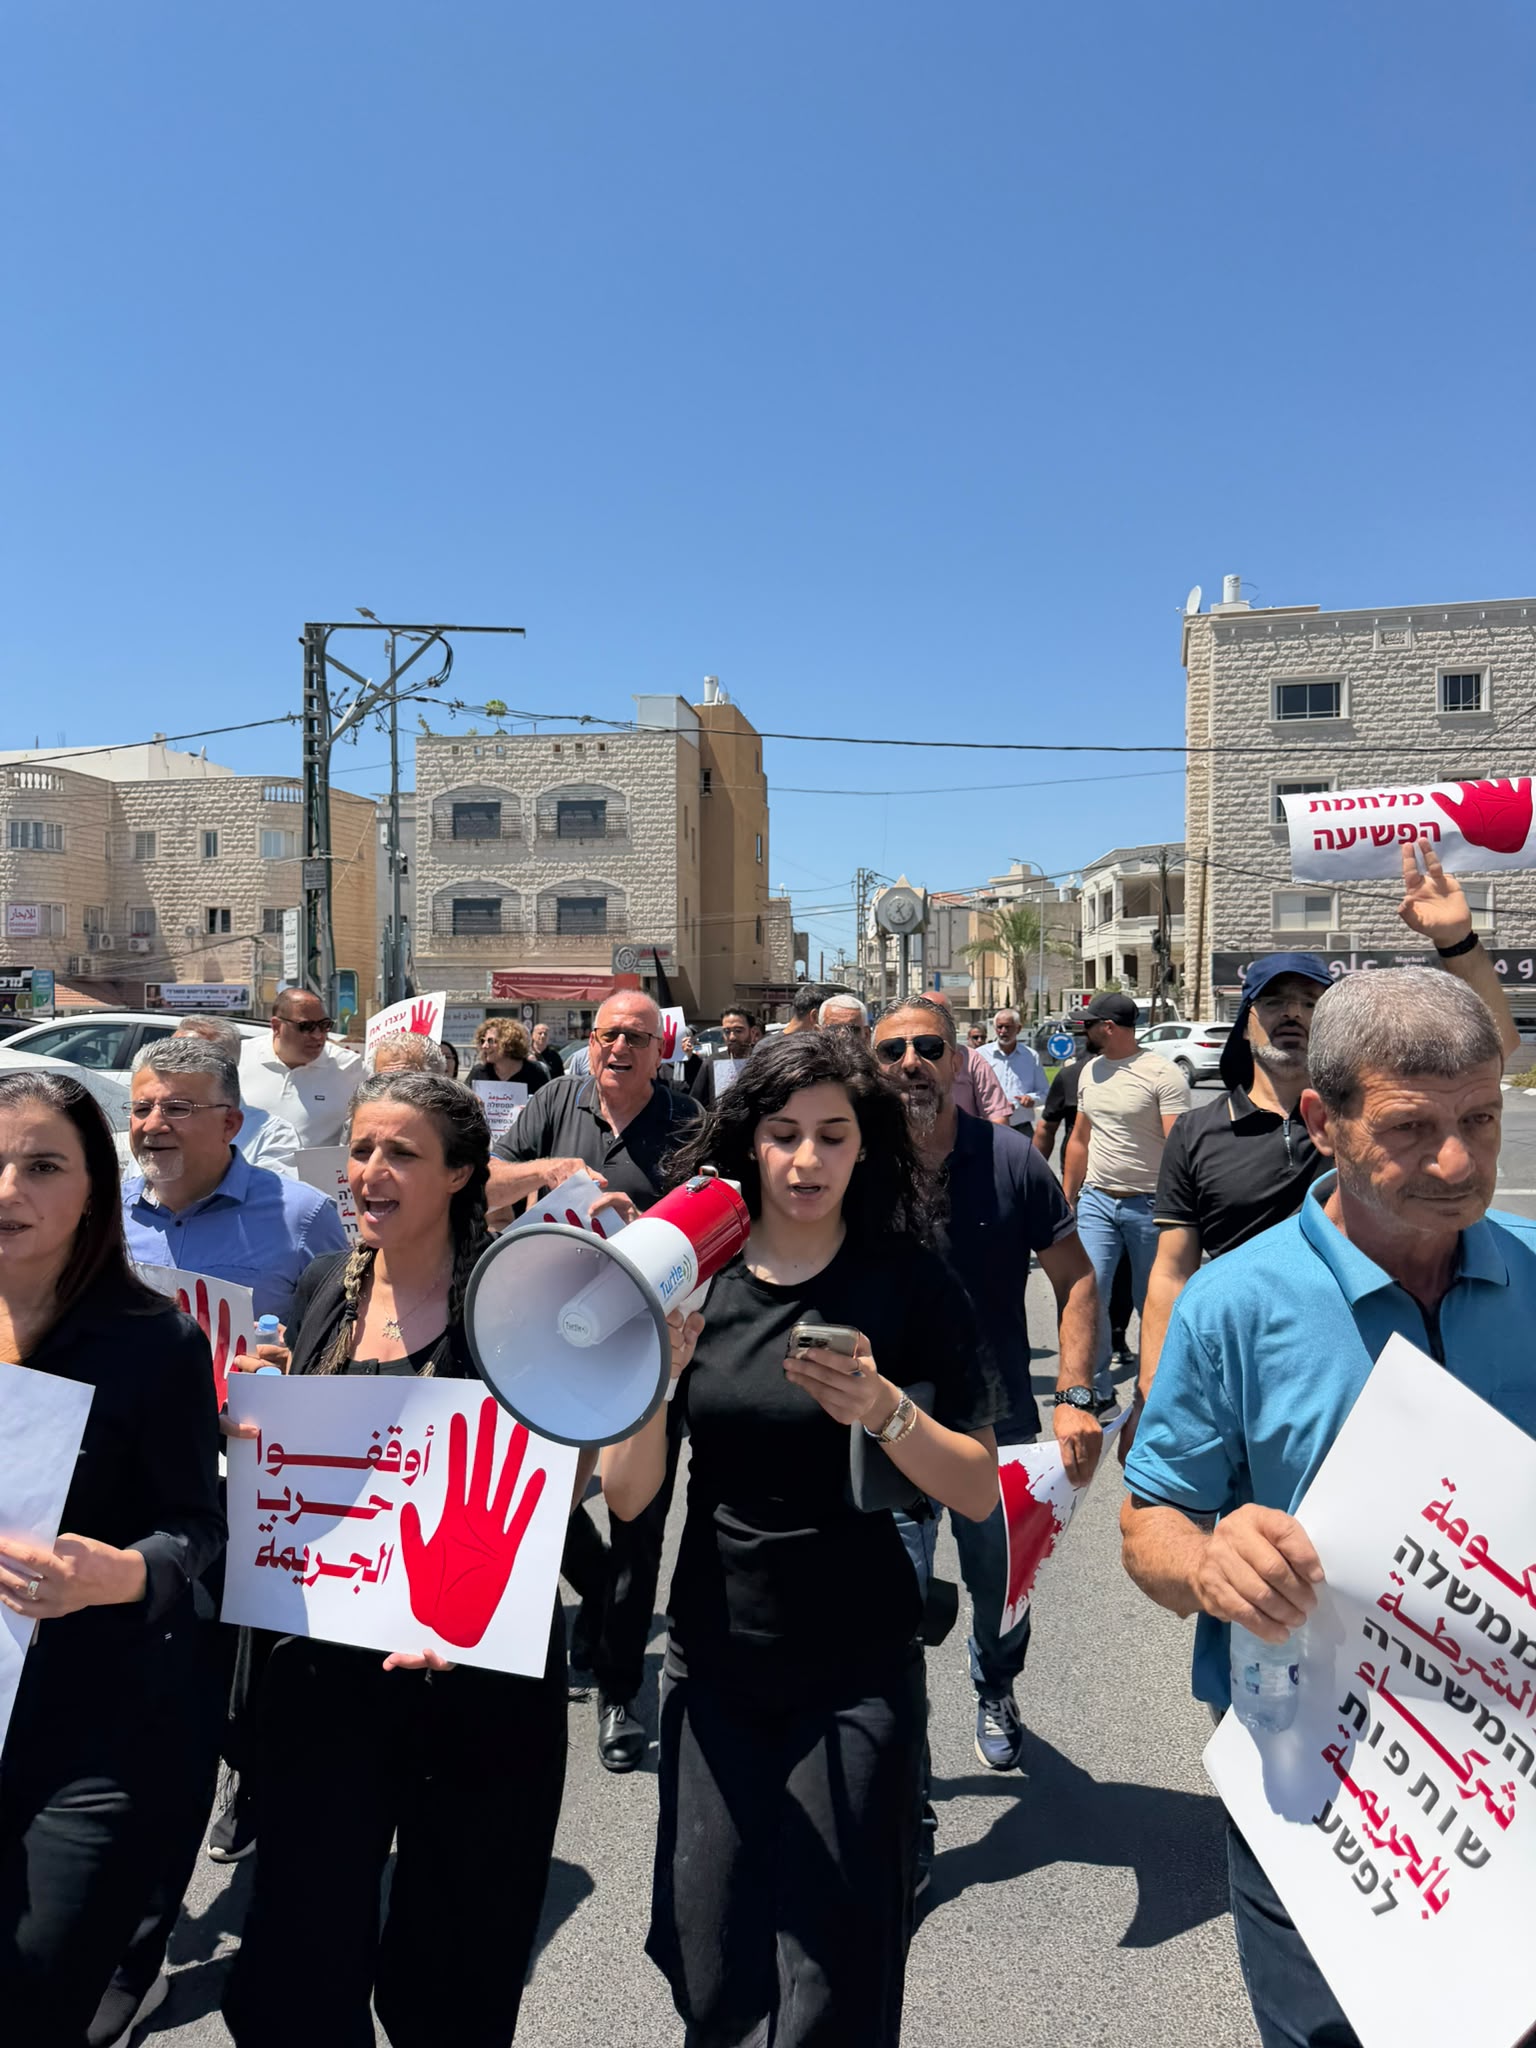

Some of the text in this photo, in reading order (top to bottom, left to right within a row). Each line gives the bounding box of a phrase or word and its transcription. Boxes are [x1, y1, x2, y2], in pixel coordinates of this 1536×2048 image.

[1308, 792, 1425, 813] מלחמת
[1313, 821, 1441, 850] הפשיעה
[660, 1264, 684, 1299] Turtle
[257, 1424, 436, 1487] أوقفوا
[257, 1485, 394, 1526] حرب
[254, 1521, 395, 1595] الجريمة
[1393, 1534, 1536, 1671] ממשלה
[1362, 1616, 1536, 1789] המשטרה
[1321, 1724, 1450, 1920] بالجريمة
[1312, 1799, 1399, 1916] לפשע
